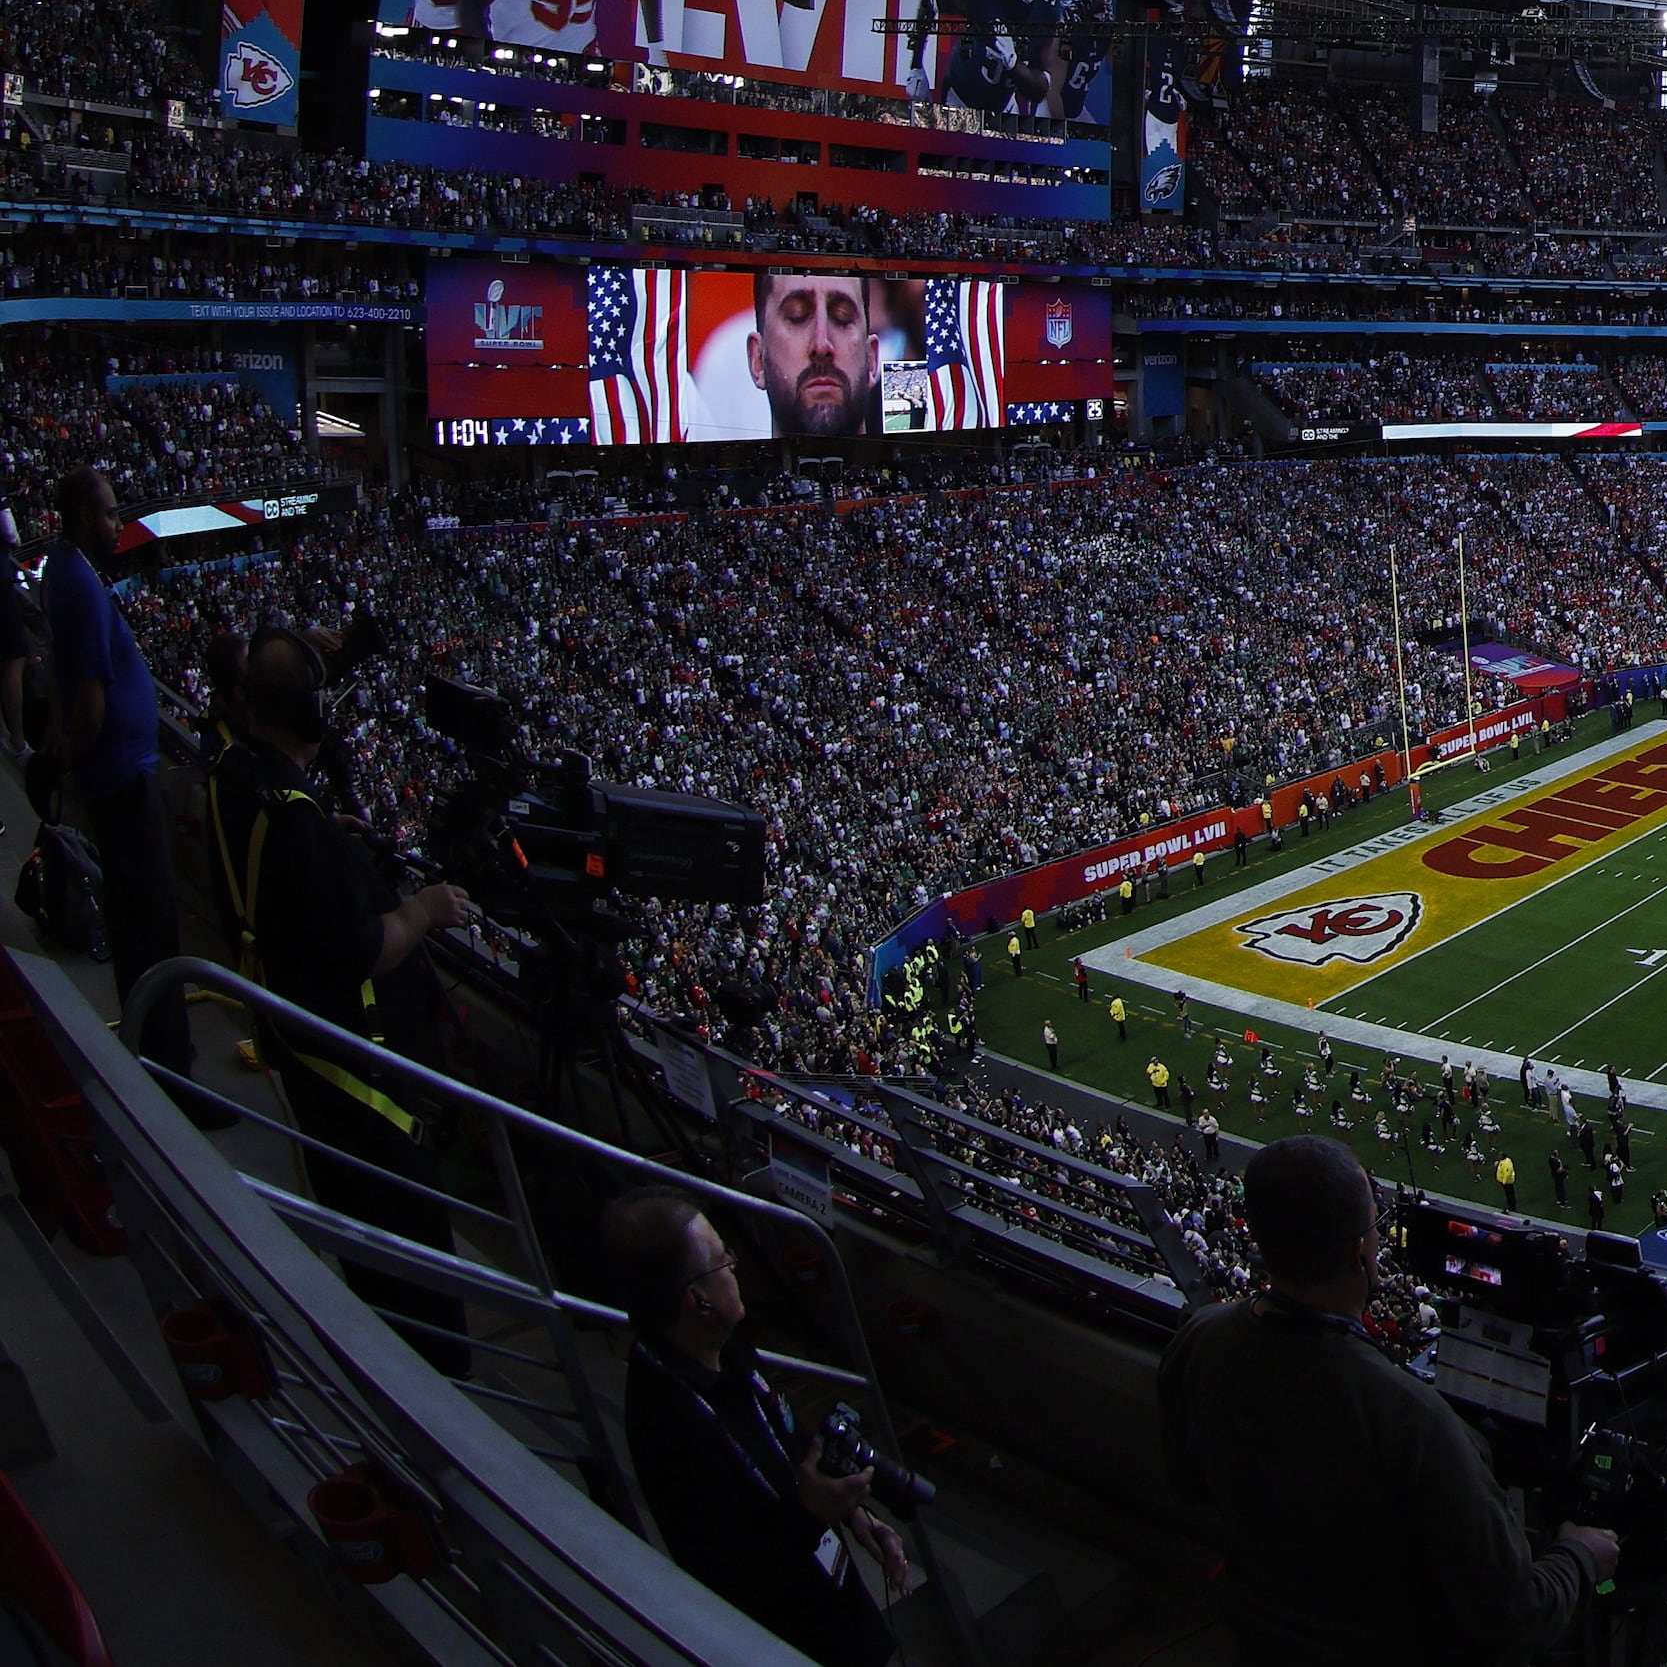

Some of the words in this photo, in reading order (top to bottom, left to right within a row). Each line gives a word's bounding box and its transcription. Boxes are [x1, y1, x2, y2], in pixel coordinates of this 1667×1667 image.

[242, 57, 278, 95] KC
[189, 304, 210, 318] TEXT
[211, 305, 232, 318] WITH
[233, 305, 256, 318] YOUR
[256, 305, 279, 318] ISSUE
[280, 305, 296, 318] AND
[296, 305, 332, 318] LOCATION
[333, 305, 345, 318] TO
[347, 307, 411, 321] 623-400-2210
[1049, 320, 1069, 341] NFL
[1143, 352, 1178, 366] verizon
[435, 419, 489, 447] 11:04
[1438, 732, 1478, 757] SUPER
[1478, 720, 1511, 742] BOWL
[1511, 710, 1534, 729] LVII
[1311, 858, 1346, 875] IT
[1343, 824, 1428, 860] TAKES
[1483, 788, 1508, 807] OF
[1513, 777, 1542, 792] US
[1084, 851, 1142, 885] SUPER
[1143, 834, 1188, 868] BOWL
[1190, 820, 1227, 853] LVII
[1275, 903, 1404, 945] KC
